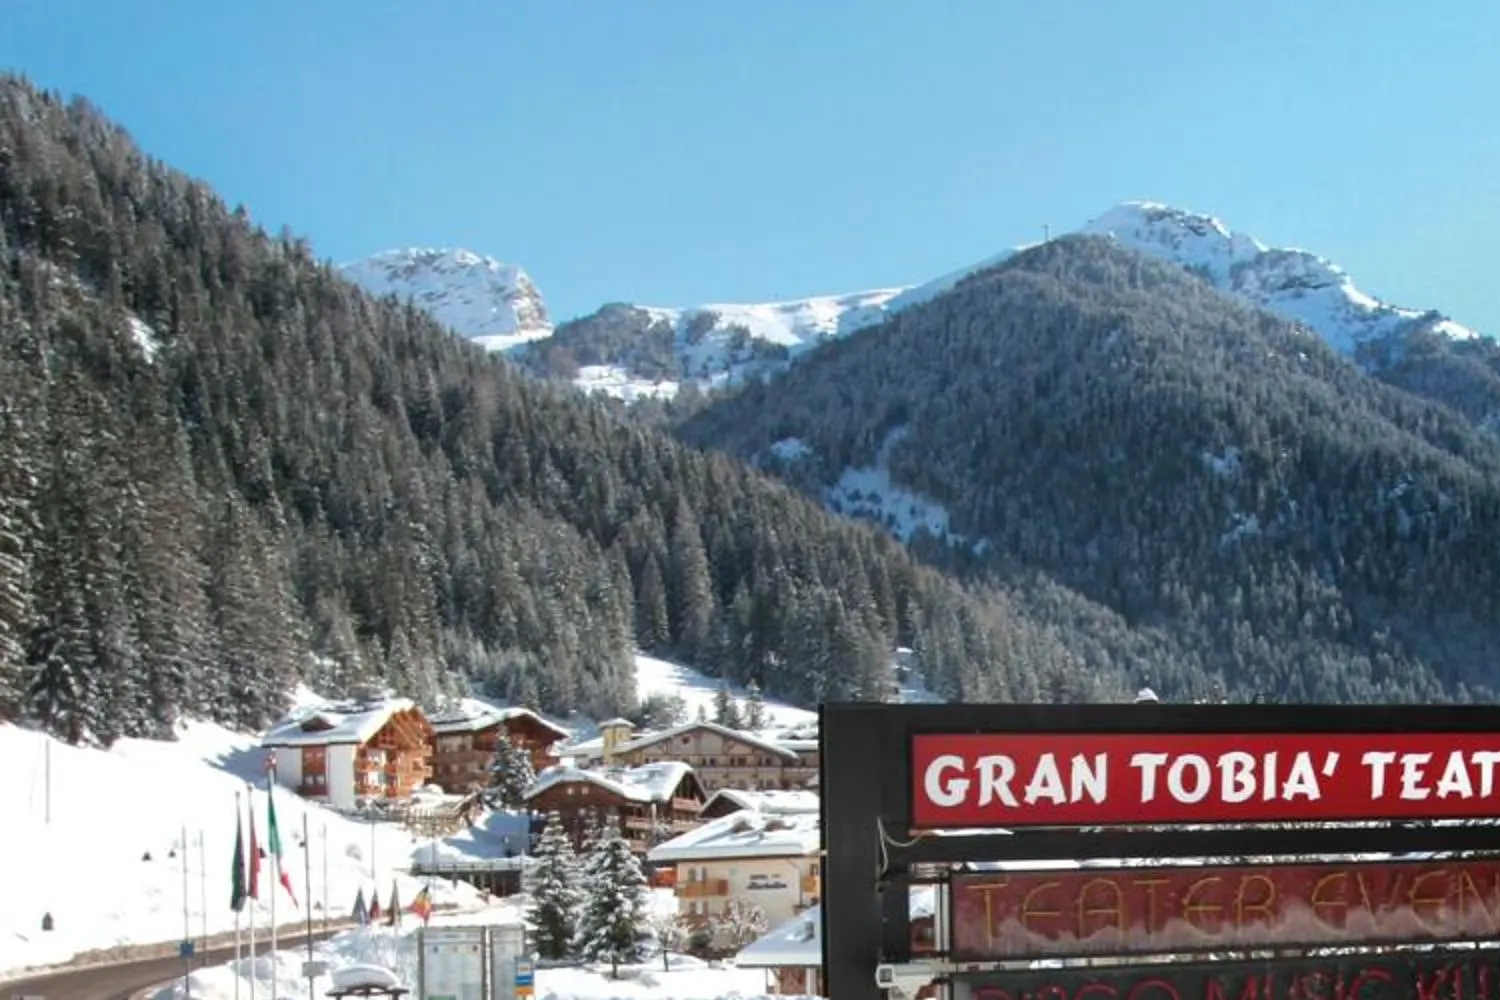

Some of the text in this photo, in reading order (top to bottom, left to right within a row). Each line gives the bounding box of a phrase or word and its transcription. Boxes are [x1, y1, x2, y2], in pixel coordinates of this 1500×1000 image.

[924, 752, 1108, 808] GRAN
[1129, 750, 1340, 804] TOBIA'
[967, 874, 1275, 950] TEATER
